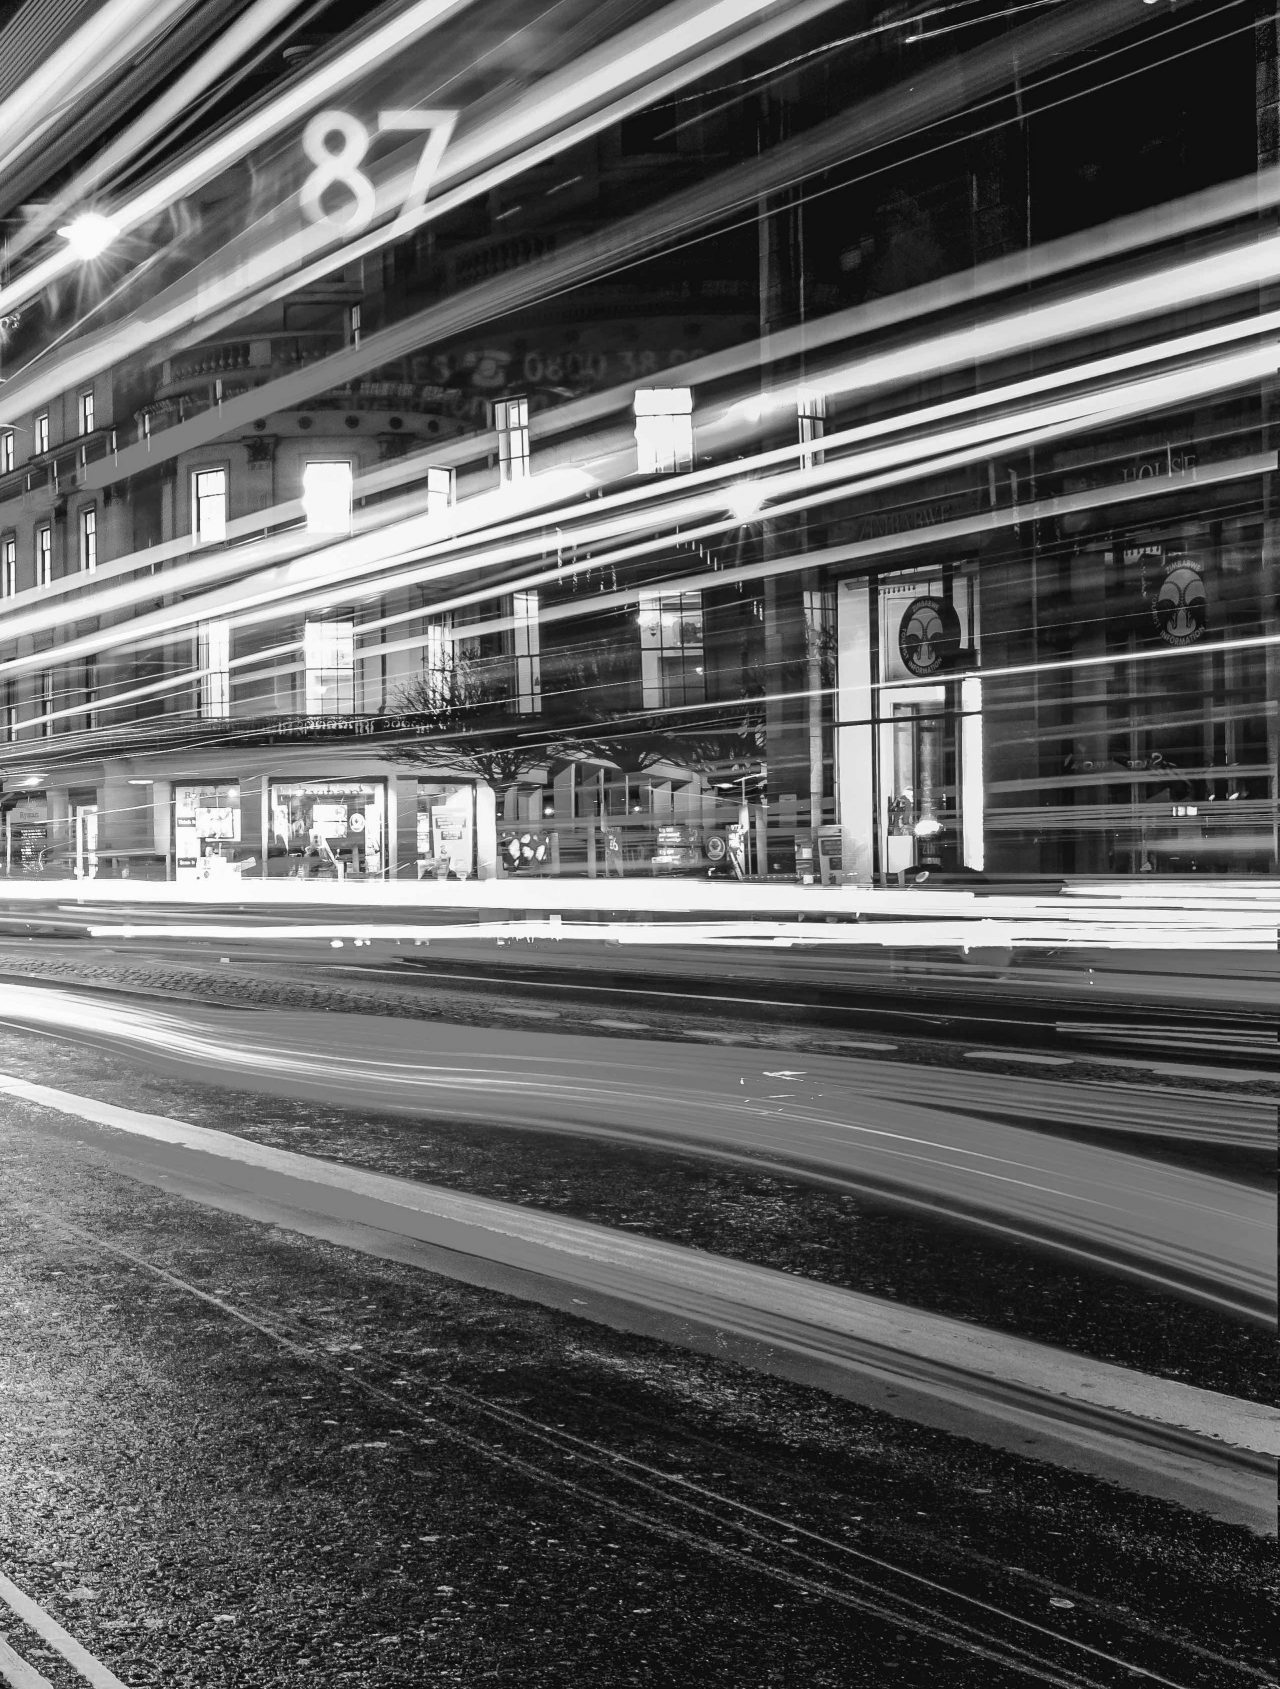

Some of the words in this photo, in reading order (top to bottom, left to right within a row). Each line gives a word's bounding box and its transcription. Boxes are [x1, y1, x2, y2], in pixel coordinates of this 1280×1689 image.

[299, 109, 461, 241] 87
[1166, 560, 1202, 574] ZIMBABWE
[1160, 623, 1206, 646] INFORMATION
[907, 656, 943, 674] INFORMATION
